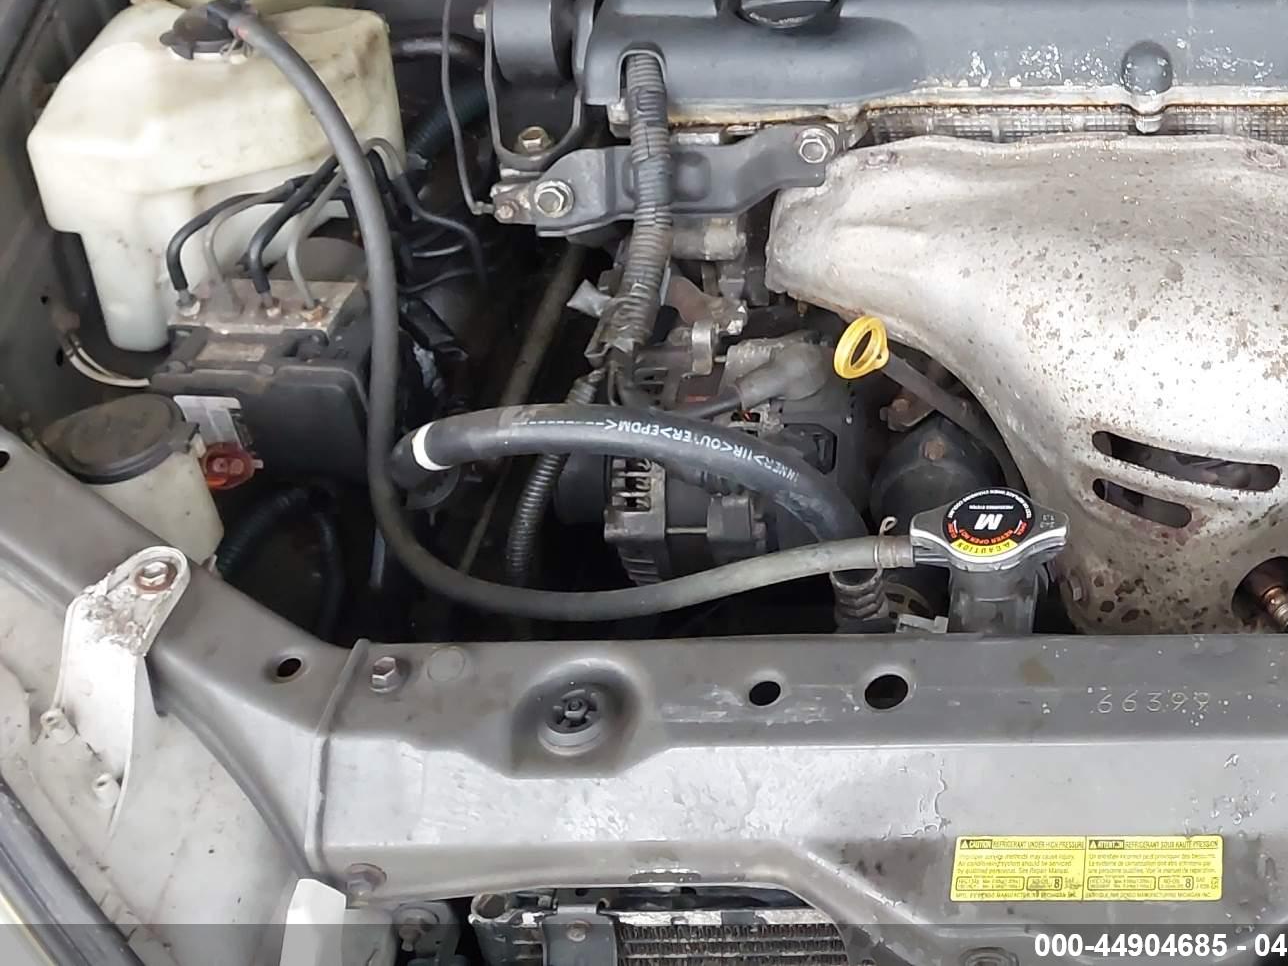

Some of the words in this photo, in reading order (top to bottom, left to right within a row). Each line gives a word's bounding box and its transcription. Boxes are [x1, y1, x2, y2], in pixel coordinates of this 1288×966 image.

[957, 541, 1001, 554] CAUTION
[968, 840, 992, 849] CAUTION
[1053, 878, 1060, 889] 8
[1184, 878, 1191, 888] 8
